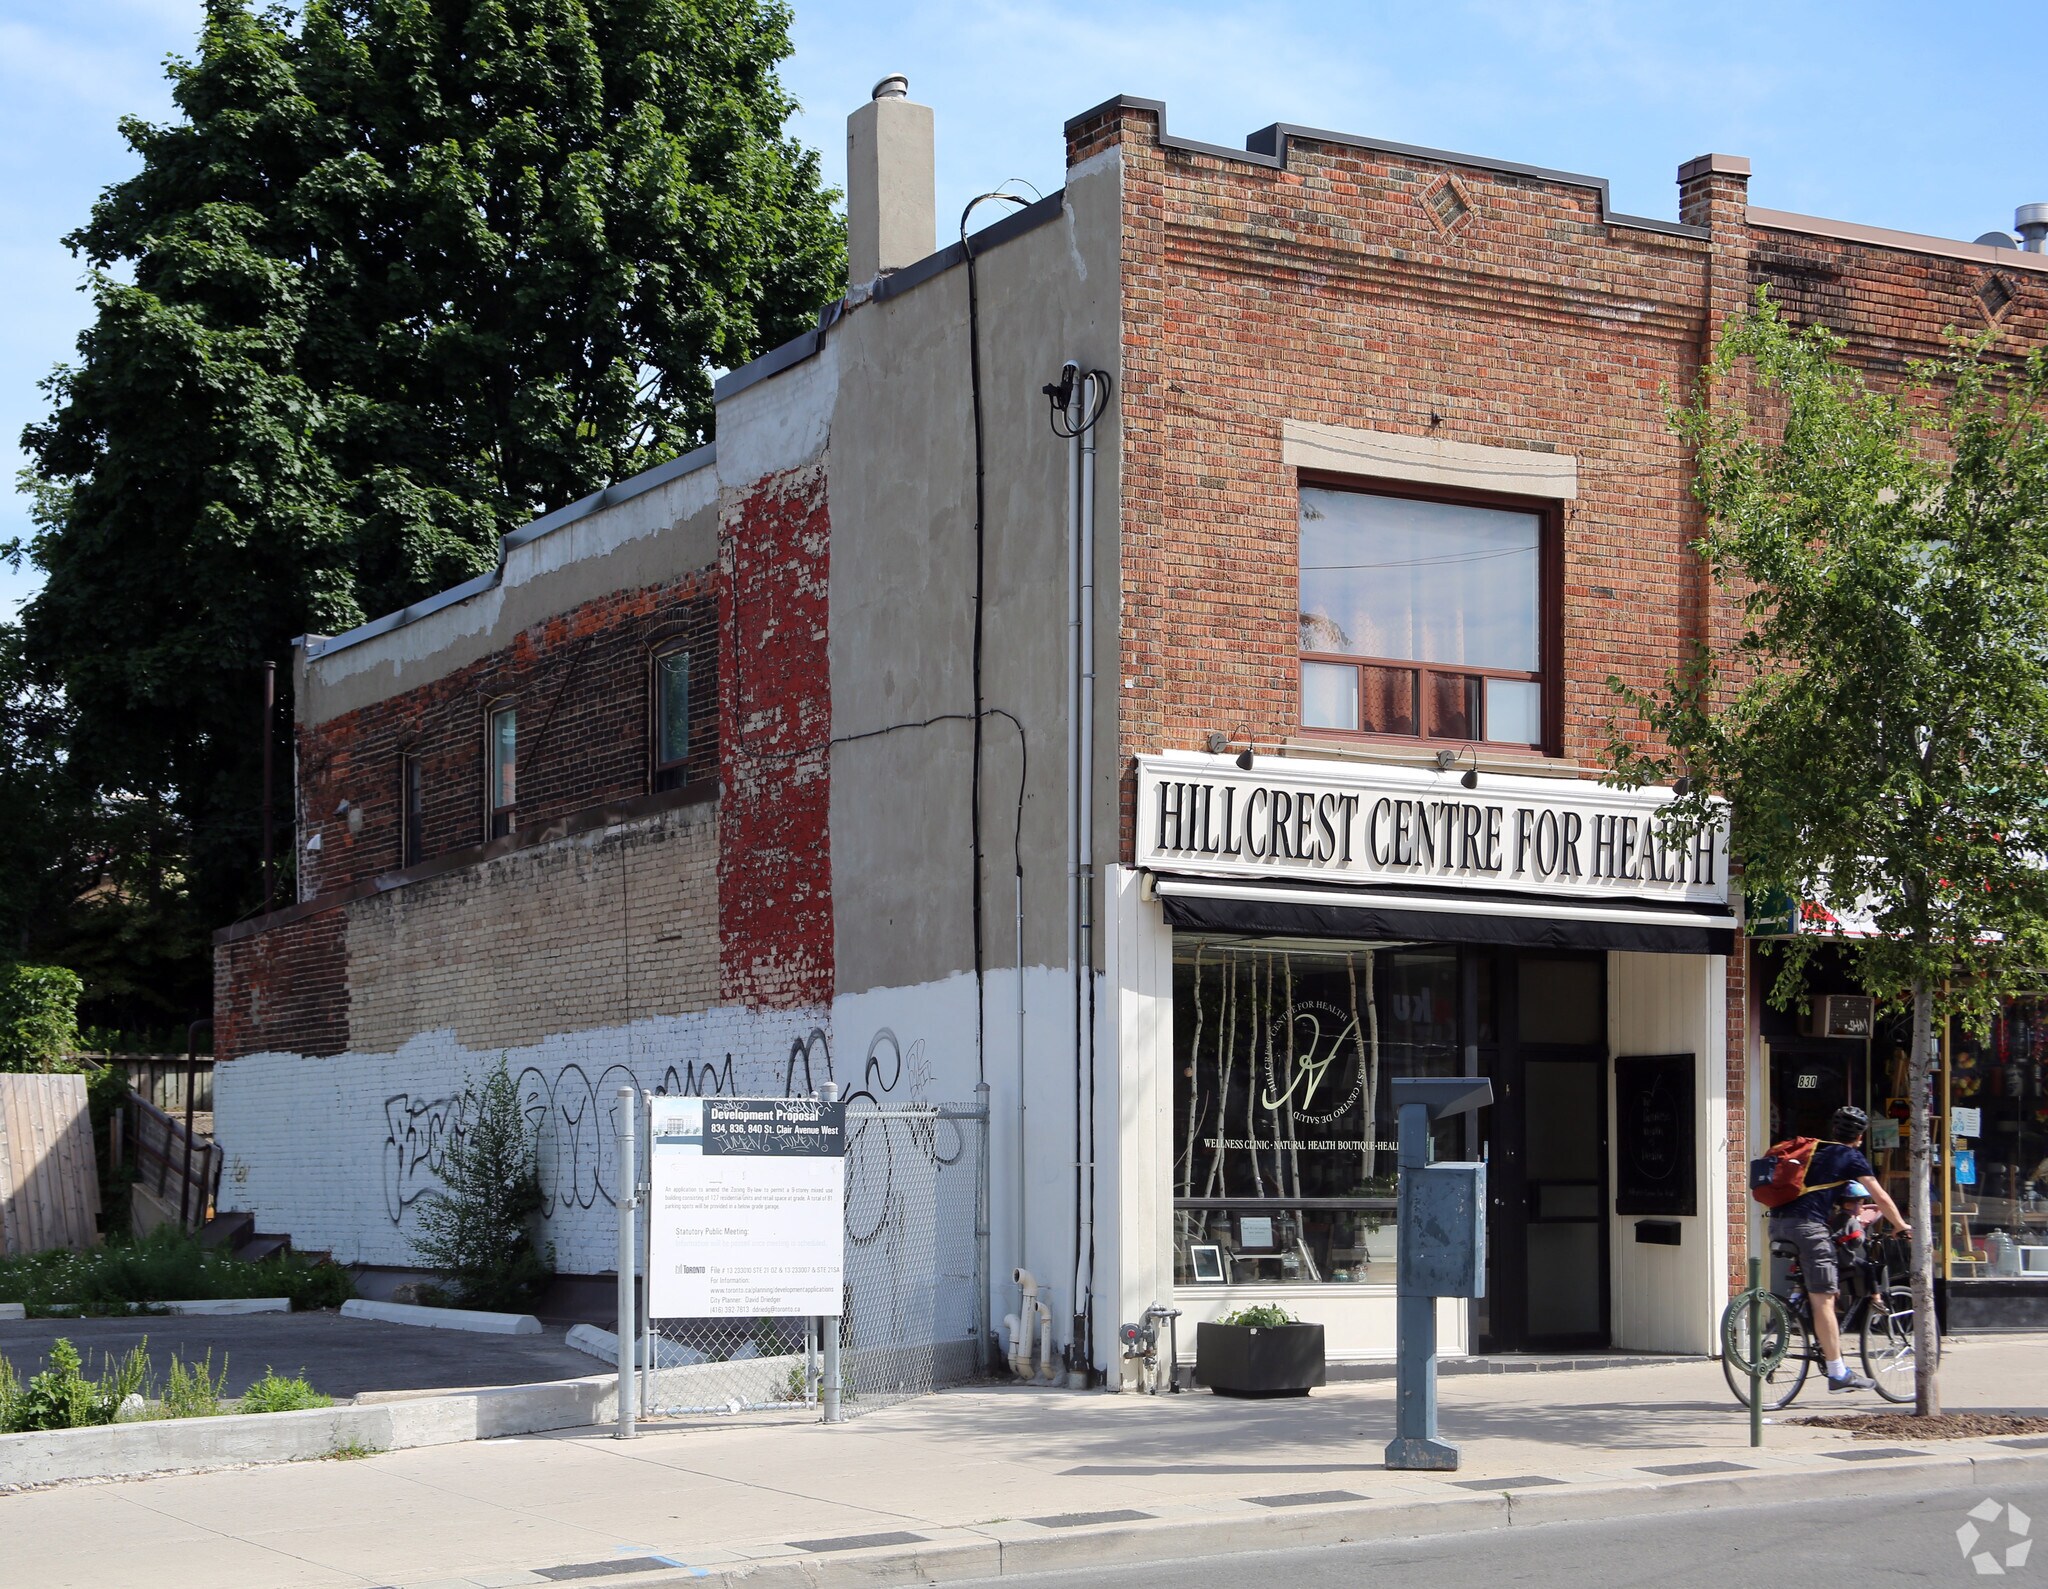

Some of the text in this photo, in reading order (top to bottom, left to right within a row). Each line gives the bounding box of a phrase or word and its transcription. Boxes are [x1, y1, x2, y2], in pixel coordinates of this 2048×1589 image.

[1157, 781, 1716, 885] HILLCREST CENTRE FOR HEALTH
[1264, 1038, 1277, 1093] HILLCREST
[1297, 1001, 1315, 1011] FOR
[1316, 1001, 1348, 1022] HEALTH
[1799, 1076, 1816, 1087] 830
[1333, 1087, 1360, 1118] CENTRO
[711, 1108, 818, 1123] Development Proposal
[1293, 1111, 1320, 1124] SALUD
[1321, 1113, 1333, 1124] DE
[711, 1123, 839, 1135] 834, 836, 840 St. Clair Avenue West
[1204, 1138, 1243, 1149] WELLNESS
[1244, 1140, 1269, 1149] CLINIC
[1274, 1140, 1306, 1150] NATURAL
[1308, 1141, 1335, 1150] HEALTH
[1338, 1141, 1374, 1152] BOUTIQUE
[676, 1227, 749, 1236] Statutory Public Meeting:
[683, 1265, 705, 1274] TORONTO
[760, 1296, 781, 1304] Driedger
